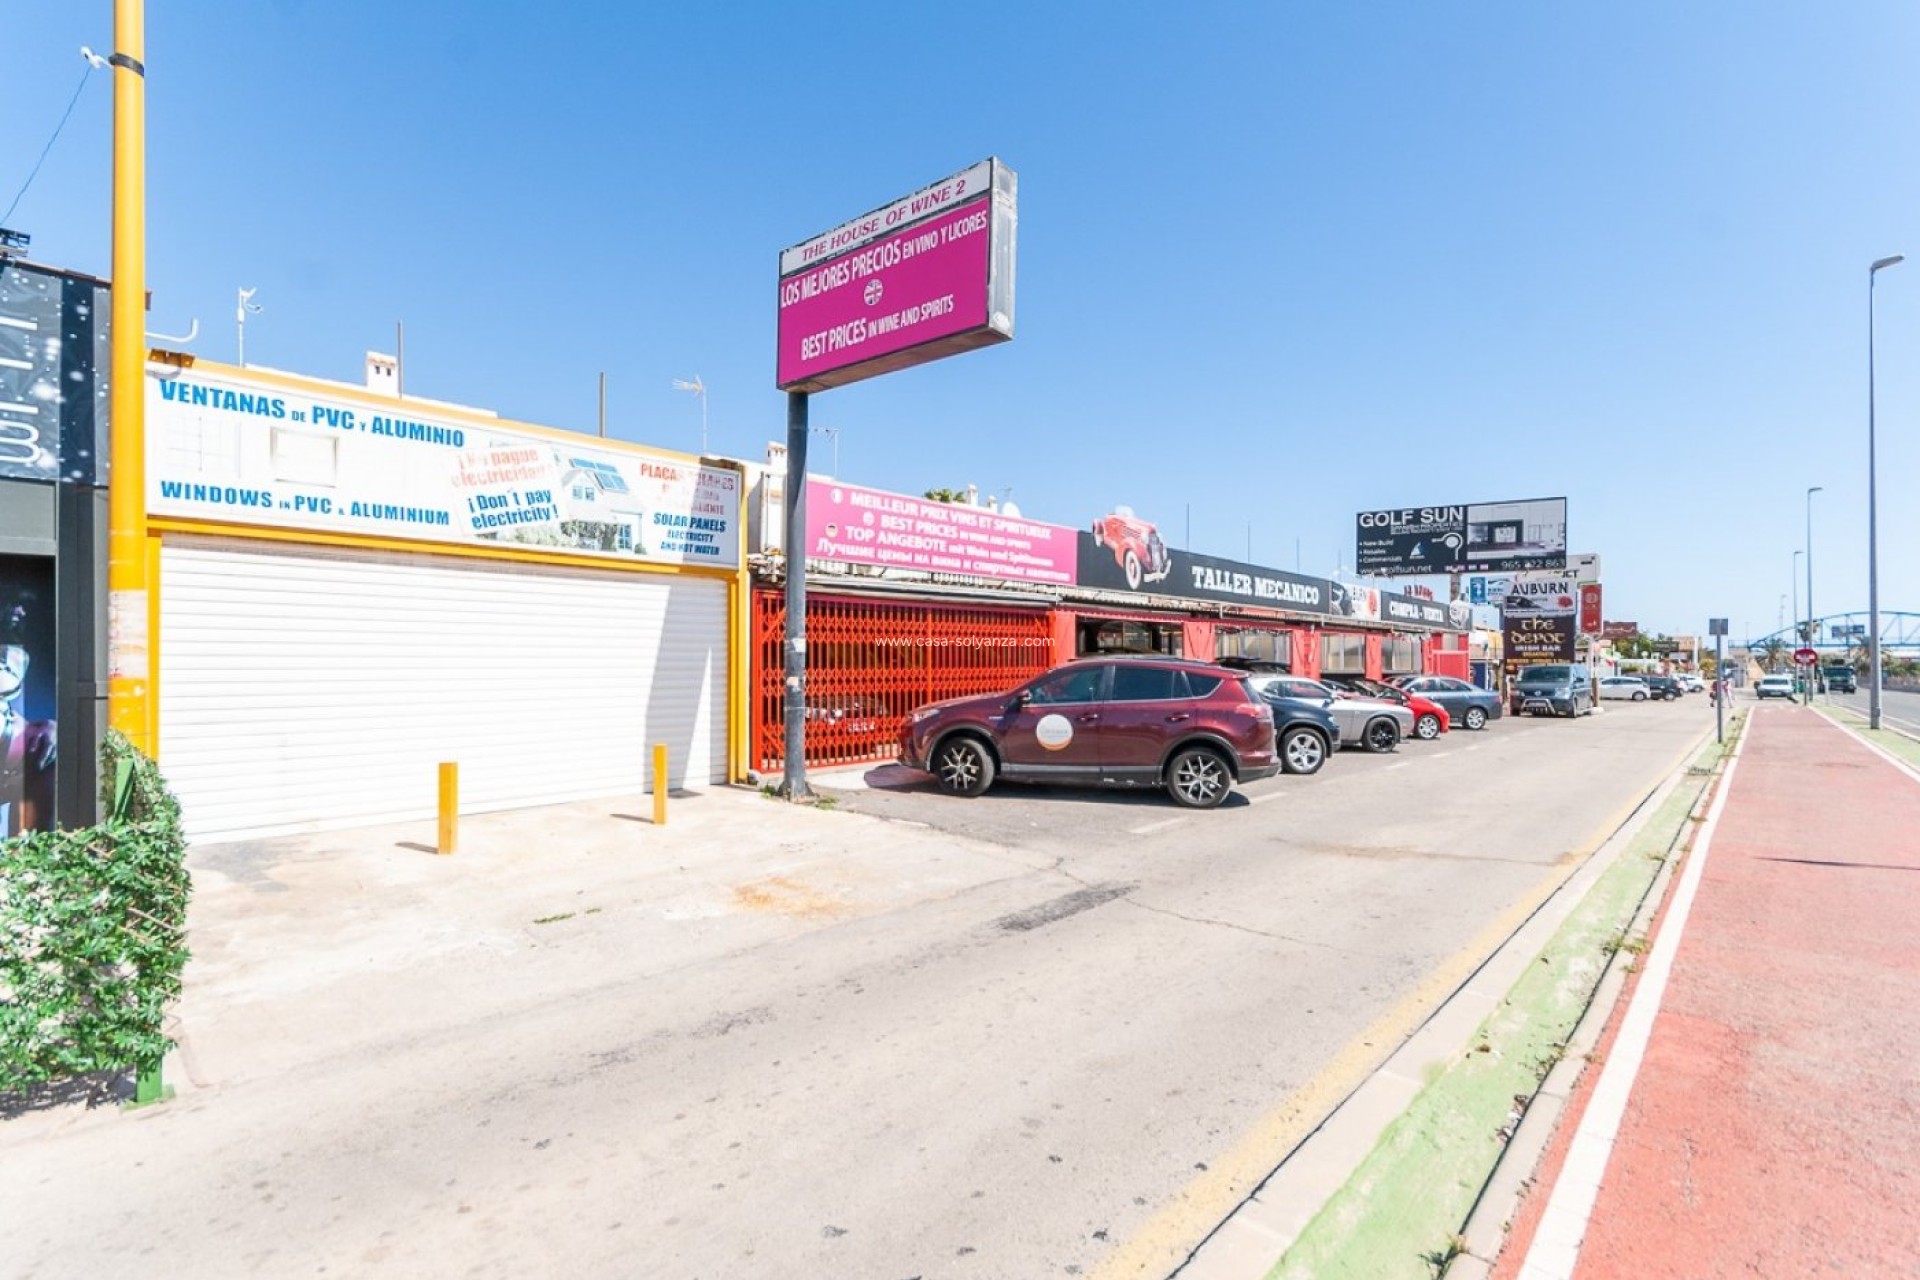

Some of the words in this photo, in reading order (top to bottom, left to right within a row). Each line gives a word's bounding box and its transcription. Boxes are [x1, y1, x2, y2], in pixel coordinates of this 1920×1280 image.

[802, 243, 826, 261] THE
[831, 218, 880, 248] HOUSE
[885, 206, 906, 225] OF
[911, 185, 951, 214] WINE
[956, 180, 966, 195] 2
[781, 281, 800, 308] LOS
[801, 263, 850, 299] MEJORES
[852, 239, 901, 280] PRECIOS
[903, 244, 913, 260] EN
[914, 233, 938, 256] VINO
[940, 229, 948, 244] Y
[949, 210, 987, 241] LICORES
[801, 334, 828, 361] BEST
[828, 318, 866, 353] PRICES
[868, 322, 877, 338] IN
[878, 312, 900, 336] WINE
[900, 305, 919, 327] AND
[921, 295, 954, 320] SPIRITS
[160, 379, 285, 419] VENTANAS
[291, 410, 306, 423] DE
[312, 405, 355, 430] PVC
[360, 421, 368, 432] Y
[372, 416, 465, 448] ALUMINIO
[161, 481, 272, 508] WINDOWS
[279, 497, 291, 510] IN
[295, 495, 332, 514] PVC
[351, 501, 450, 526] ALUMINIUM
[525, 490, 551, 506] pay
[850, 491, 918, 516] MEILLEUR
[920, 504, 948, 522] PRIX
[949, 508, 977, 527] VINS
[978, 514, 992, 529] ET
[653, 512, 688, 526] SOLAR
[690, 517, 727, 532] PANELS
[881, 514, 914, 532] BEST
[915, 521, 958, 539] PRICES
[1359, 510, 1414, 527] GOLF
[1420, 506, 1464, 524] SUN
[845, 525, 874, 543] TOP
[877, 532, 947, 553] ANGEBOTE
[1191, 565, 1253, 595] TALLER
[1254, 576, 1319, 605] MECANICO
[1512, 582, 1568, 595] AUBURN
[1542, 644, 1561, 652] BAR
